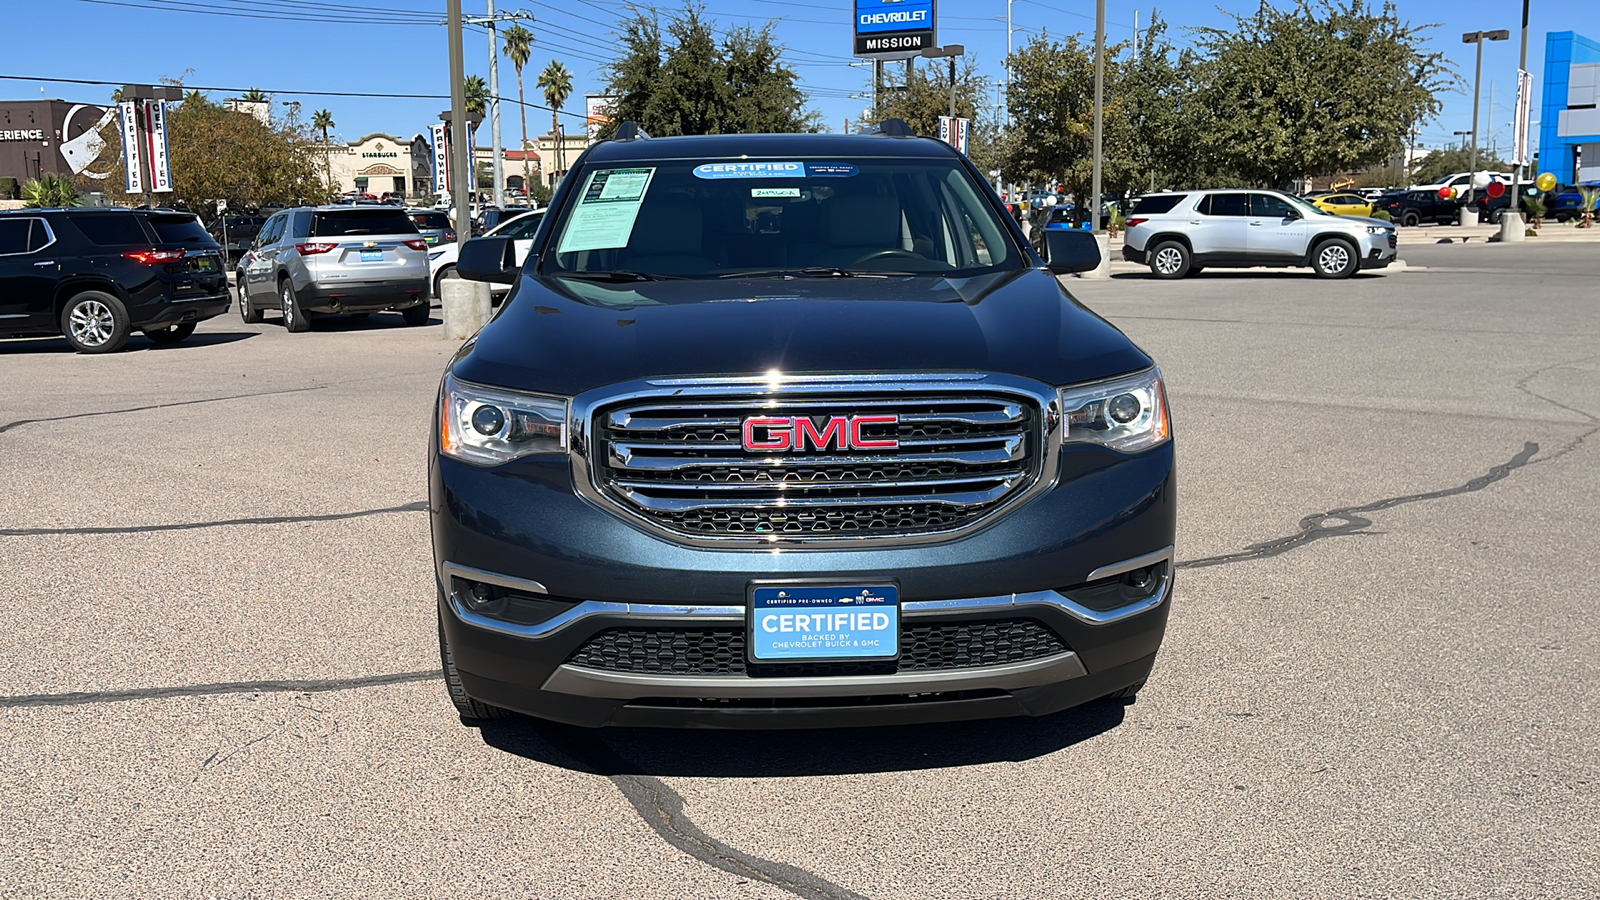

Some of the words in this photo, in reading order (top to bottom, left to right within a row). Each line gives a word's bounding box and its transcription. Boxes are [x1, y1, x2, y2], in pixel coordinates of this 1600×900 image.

[860, 10, 928, 25] CHEVROLET
[866, 36, 921, 50] MISSION
[125, 106, 138, 188] CERTIFIED
[152, 103, 167, 187] CERTIFIED
[700, 164, 798, 173] CERTIFIED
[742, 415, 899, 452] GMC
[762, 612, 890, 633] CERTIFIED
[772, 640, 822, 649] CHEVROLET
[825, 640, 851, 648] BUICK
[861, 639, 880, 647] GMC
